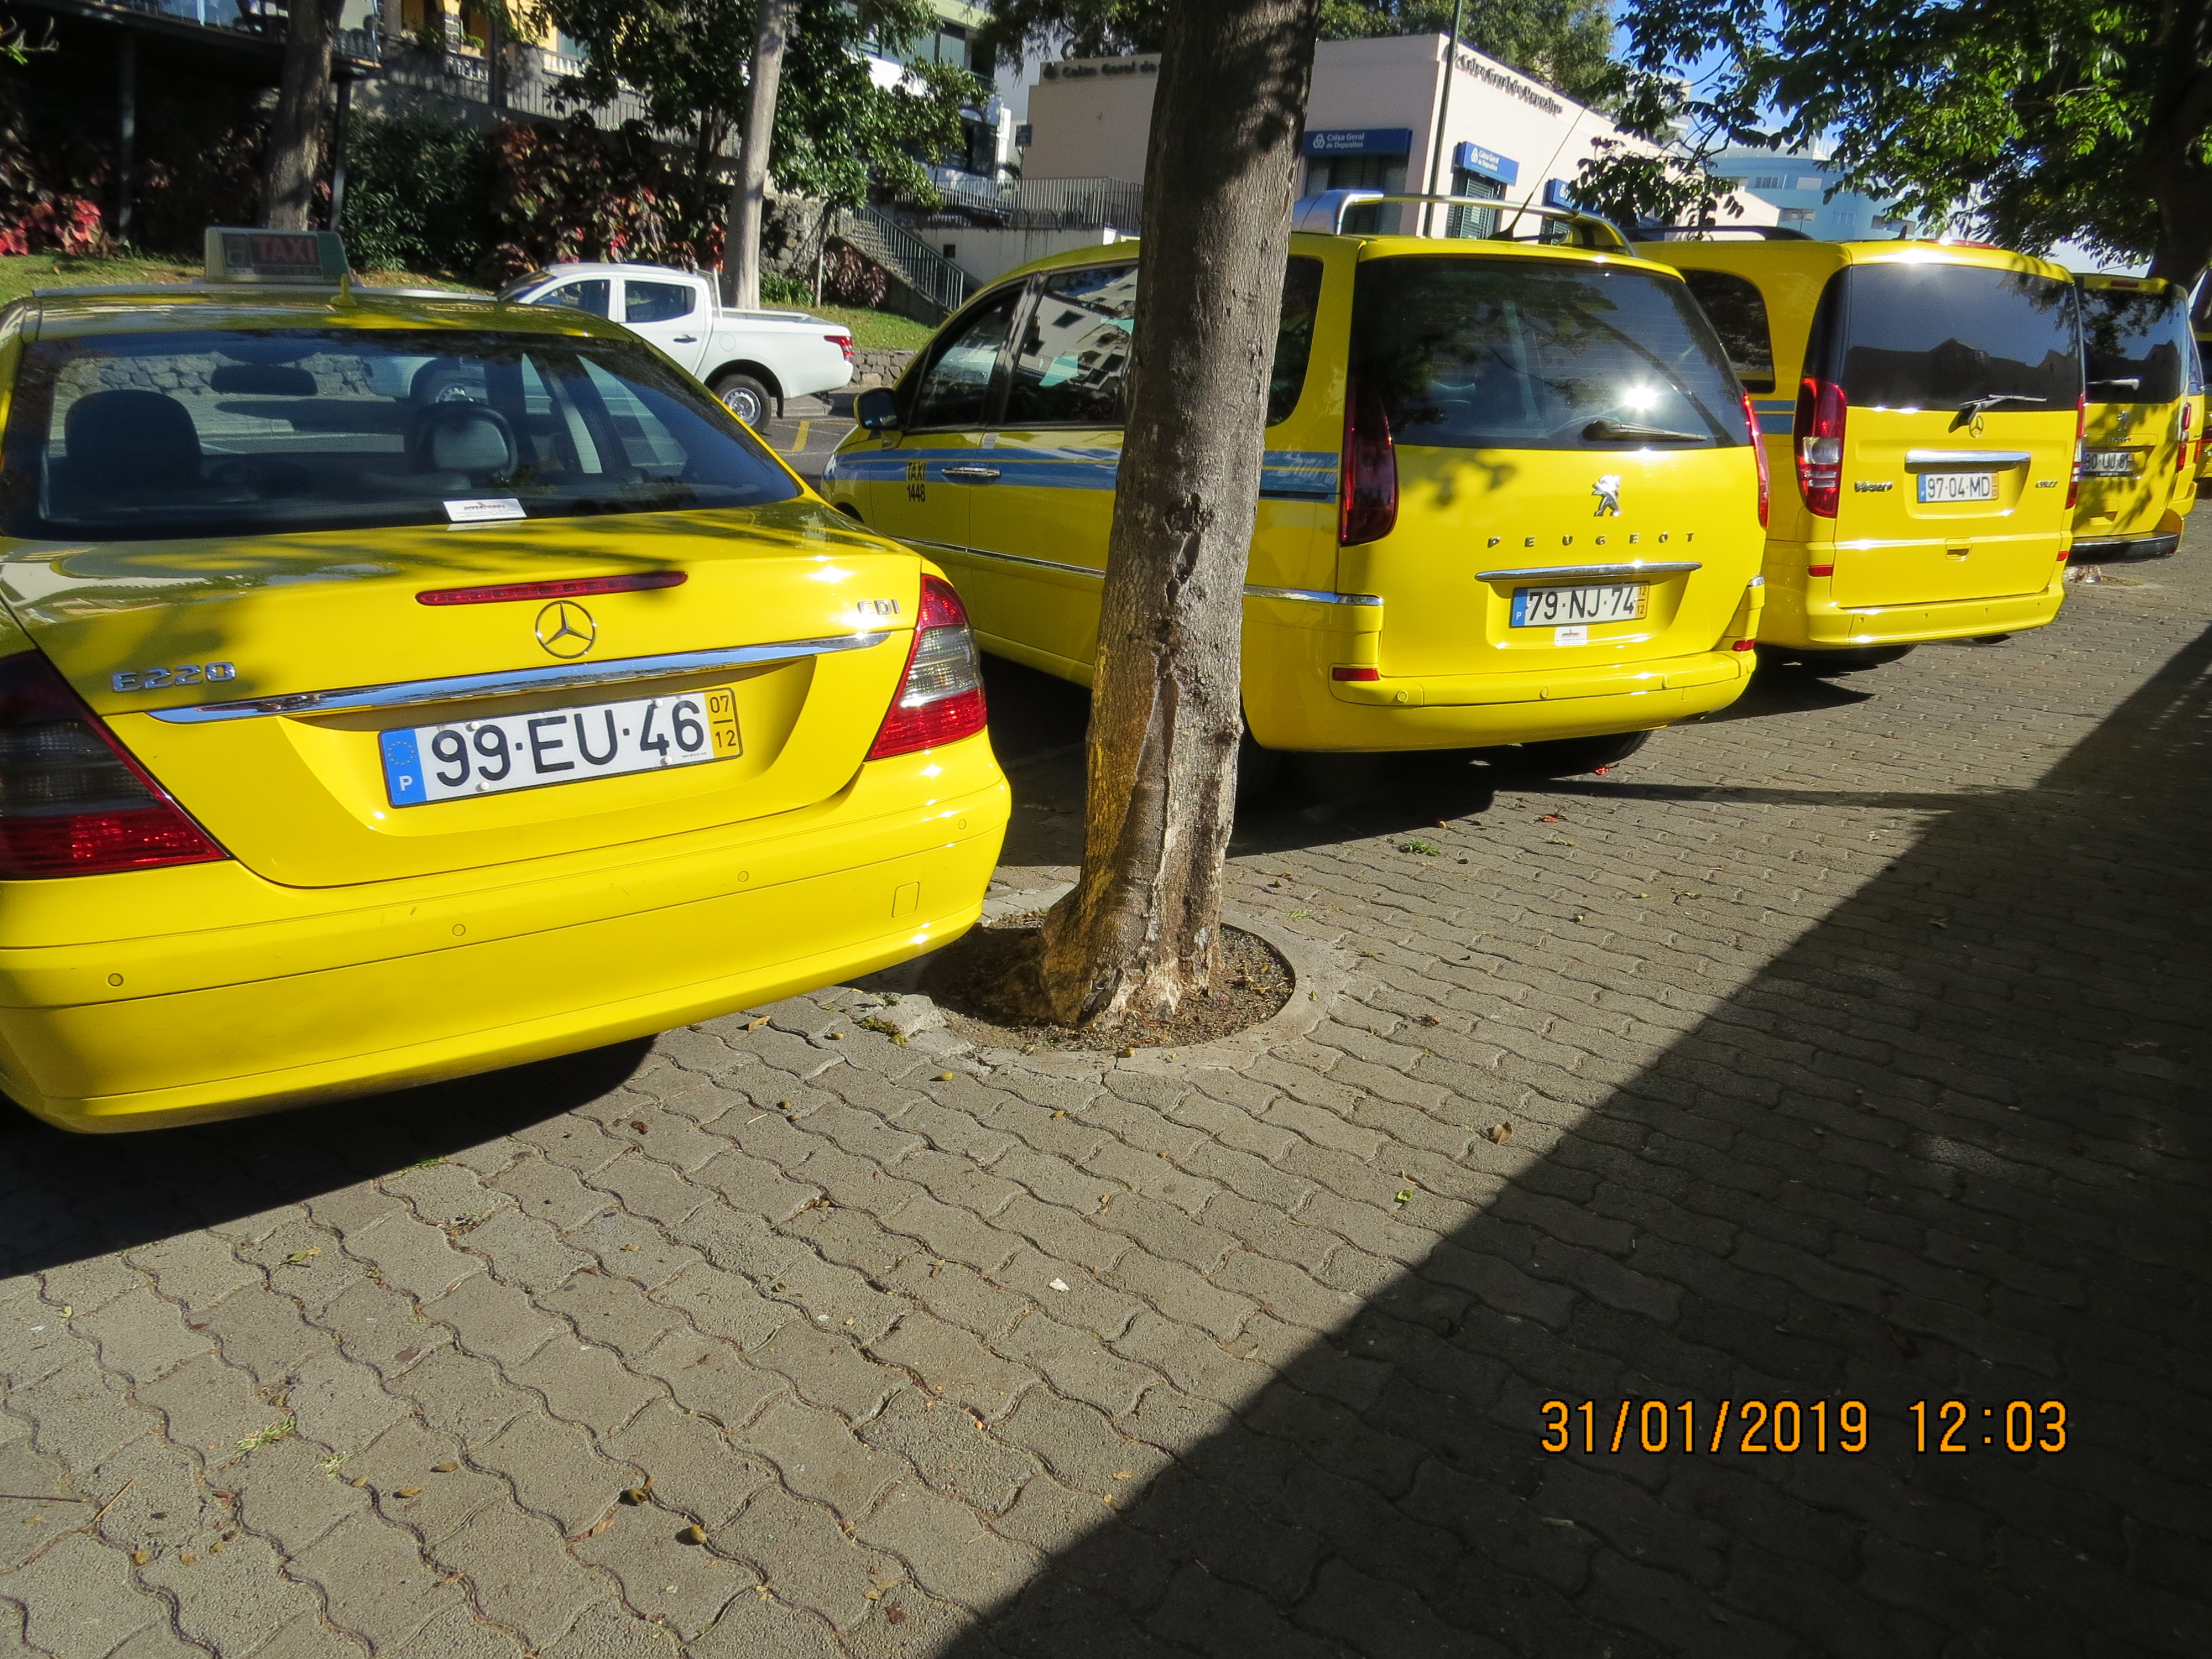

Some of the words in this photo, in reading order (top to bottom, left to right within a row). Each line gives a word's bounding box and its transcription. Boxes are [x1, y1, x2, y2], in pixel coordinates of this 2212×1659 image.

[253, 236, 315, 262] TAXI
[908, 462, 926, 481] TAXI
[907, 483, 925, 502] 1448
[1488, 531, 1694, 548] PEUGEOT
[1638, 586, 1646, 596] 12
[857, 599, 900, 615] CDI
[1515, 612, 1522, 620] P
[1636, 604, 1645, 614] 12
[112, 661, 237, 692] E220
[709, 695, 730, 714] 07
[715, 730, 737, 749] 12
[399, 775, 413, 792] P
